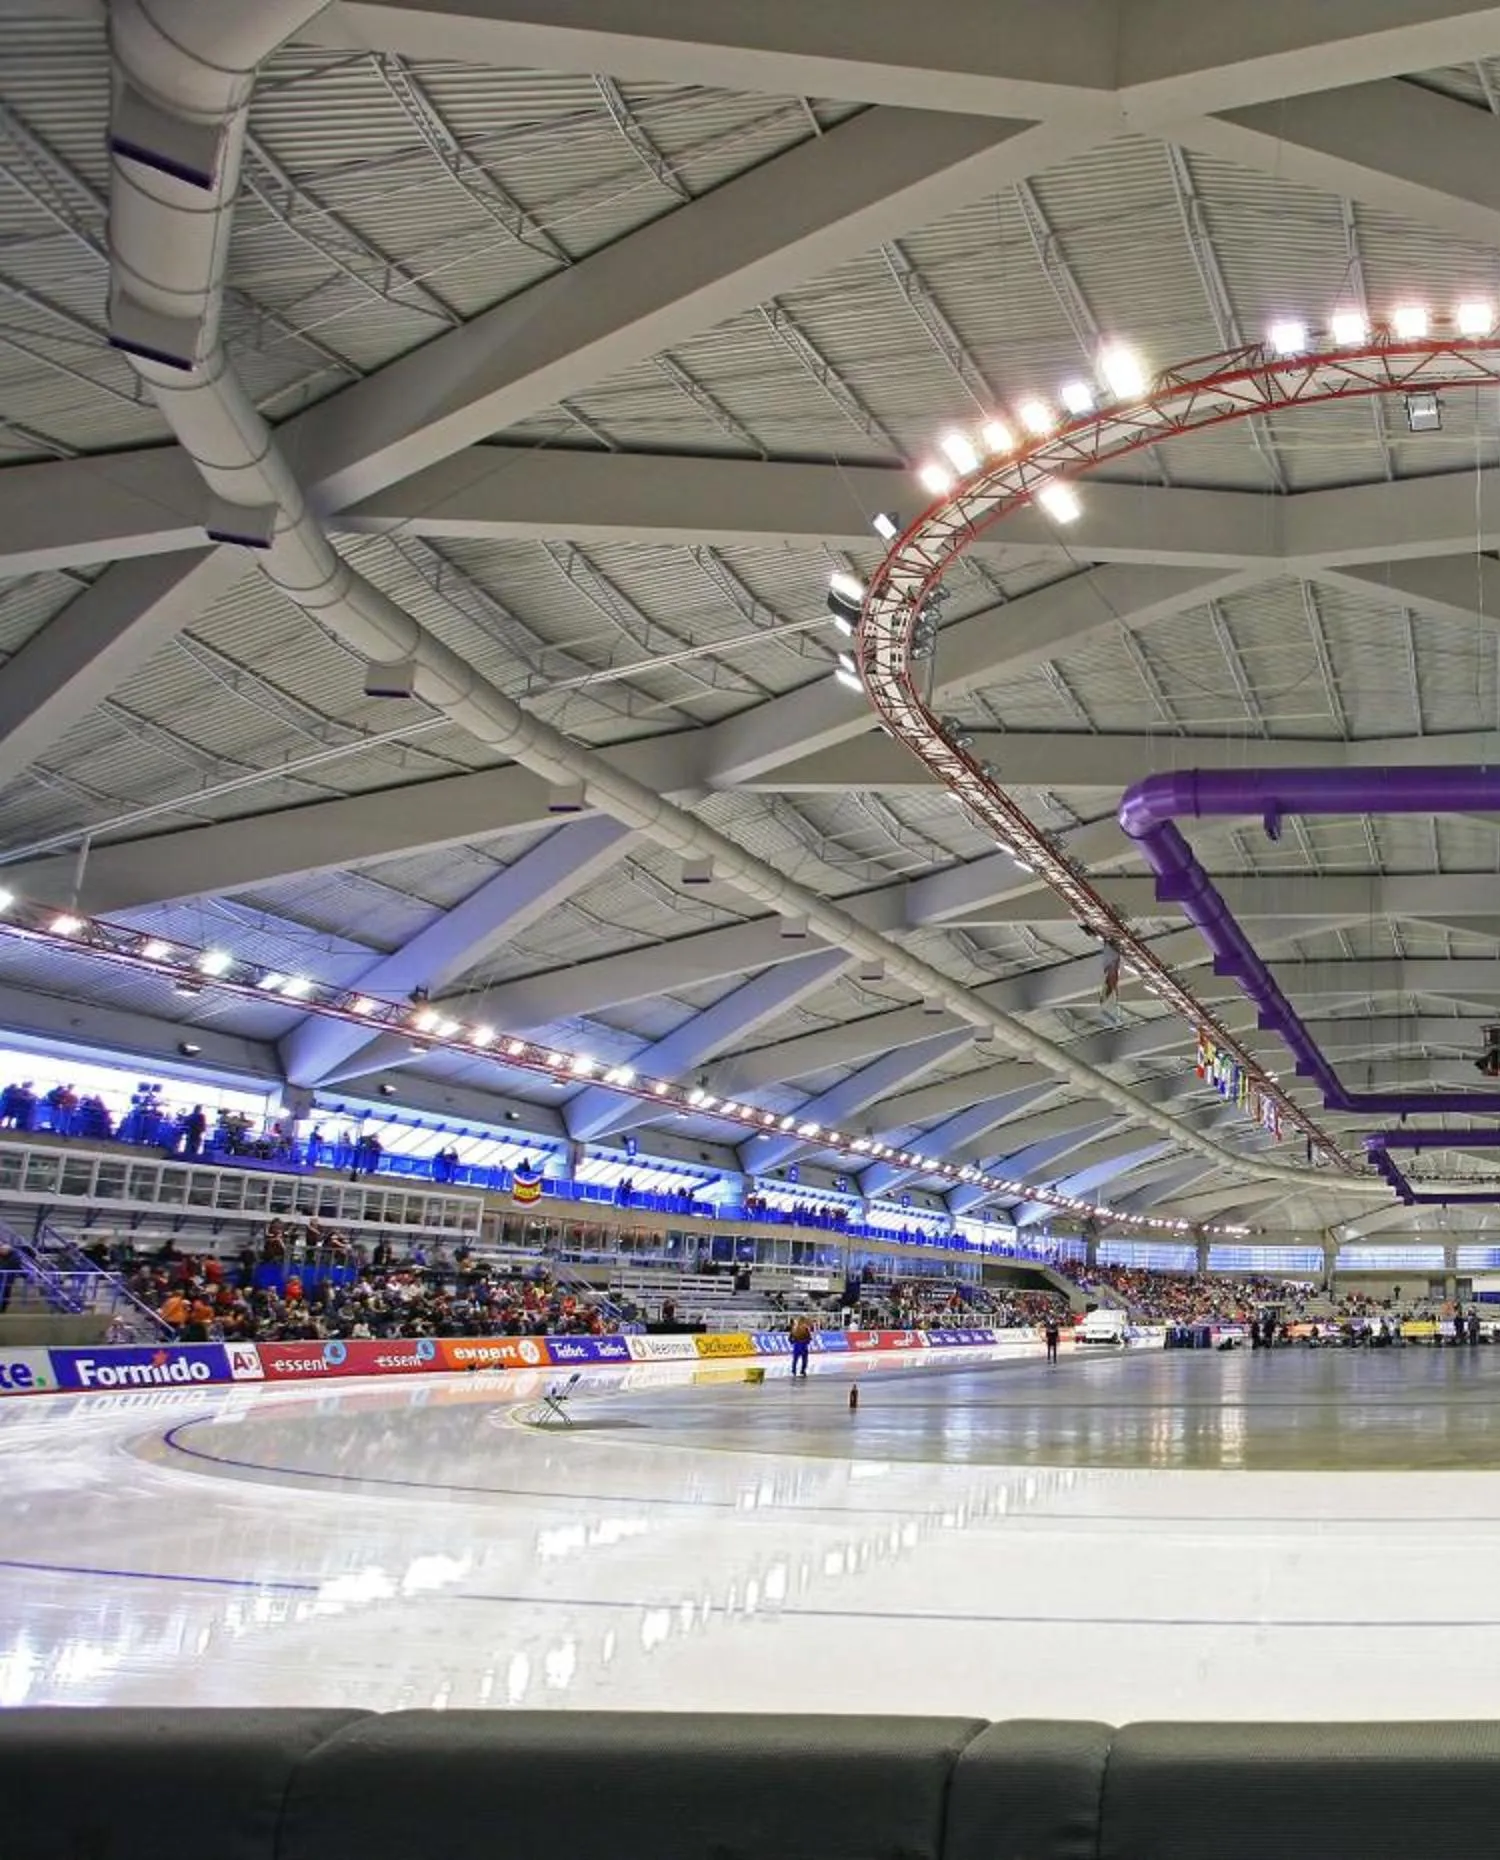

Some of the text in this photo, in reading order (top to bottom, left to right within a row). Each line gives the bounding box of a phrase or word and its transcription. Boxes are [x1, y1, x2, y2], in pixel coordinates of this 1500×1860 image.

[233, 1350, 260, 1371] AD
[453, 1345, 517, 1361] expert
[76, 1351, 210, 1386] Formido
[270, 1355, 330, 1372] essent
